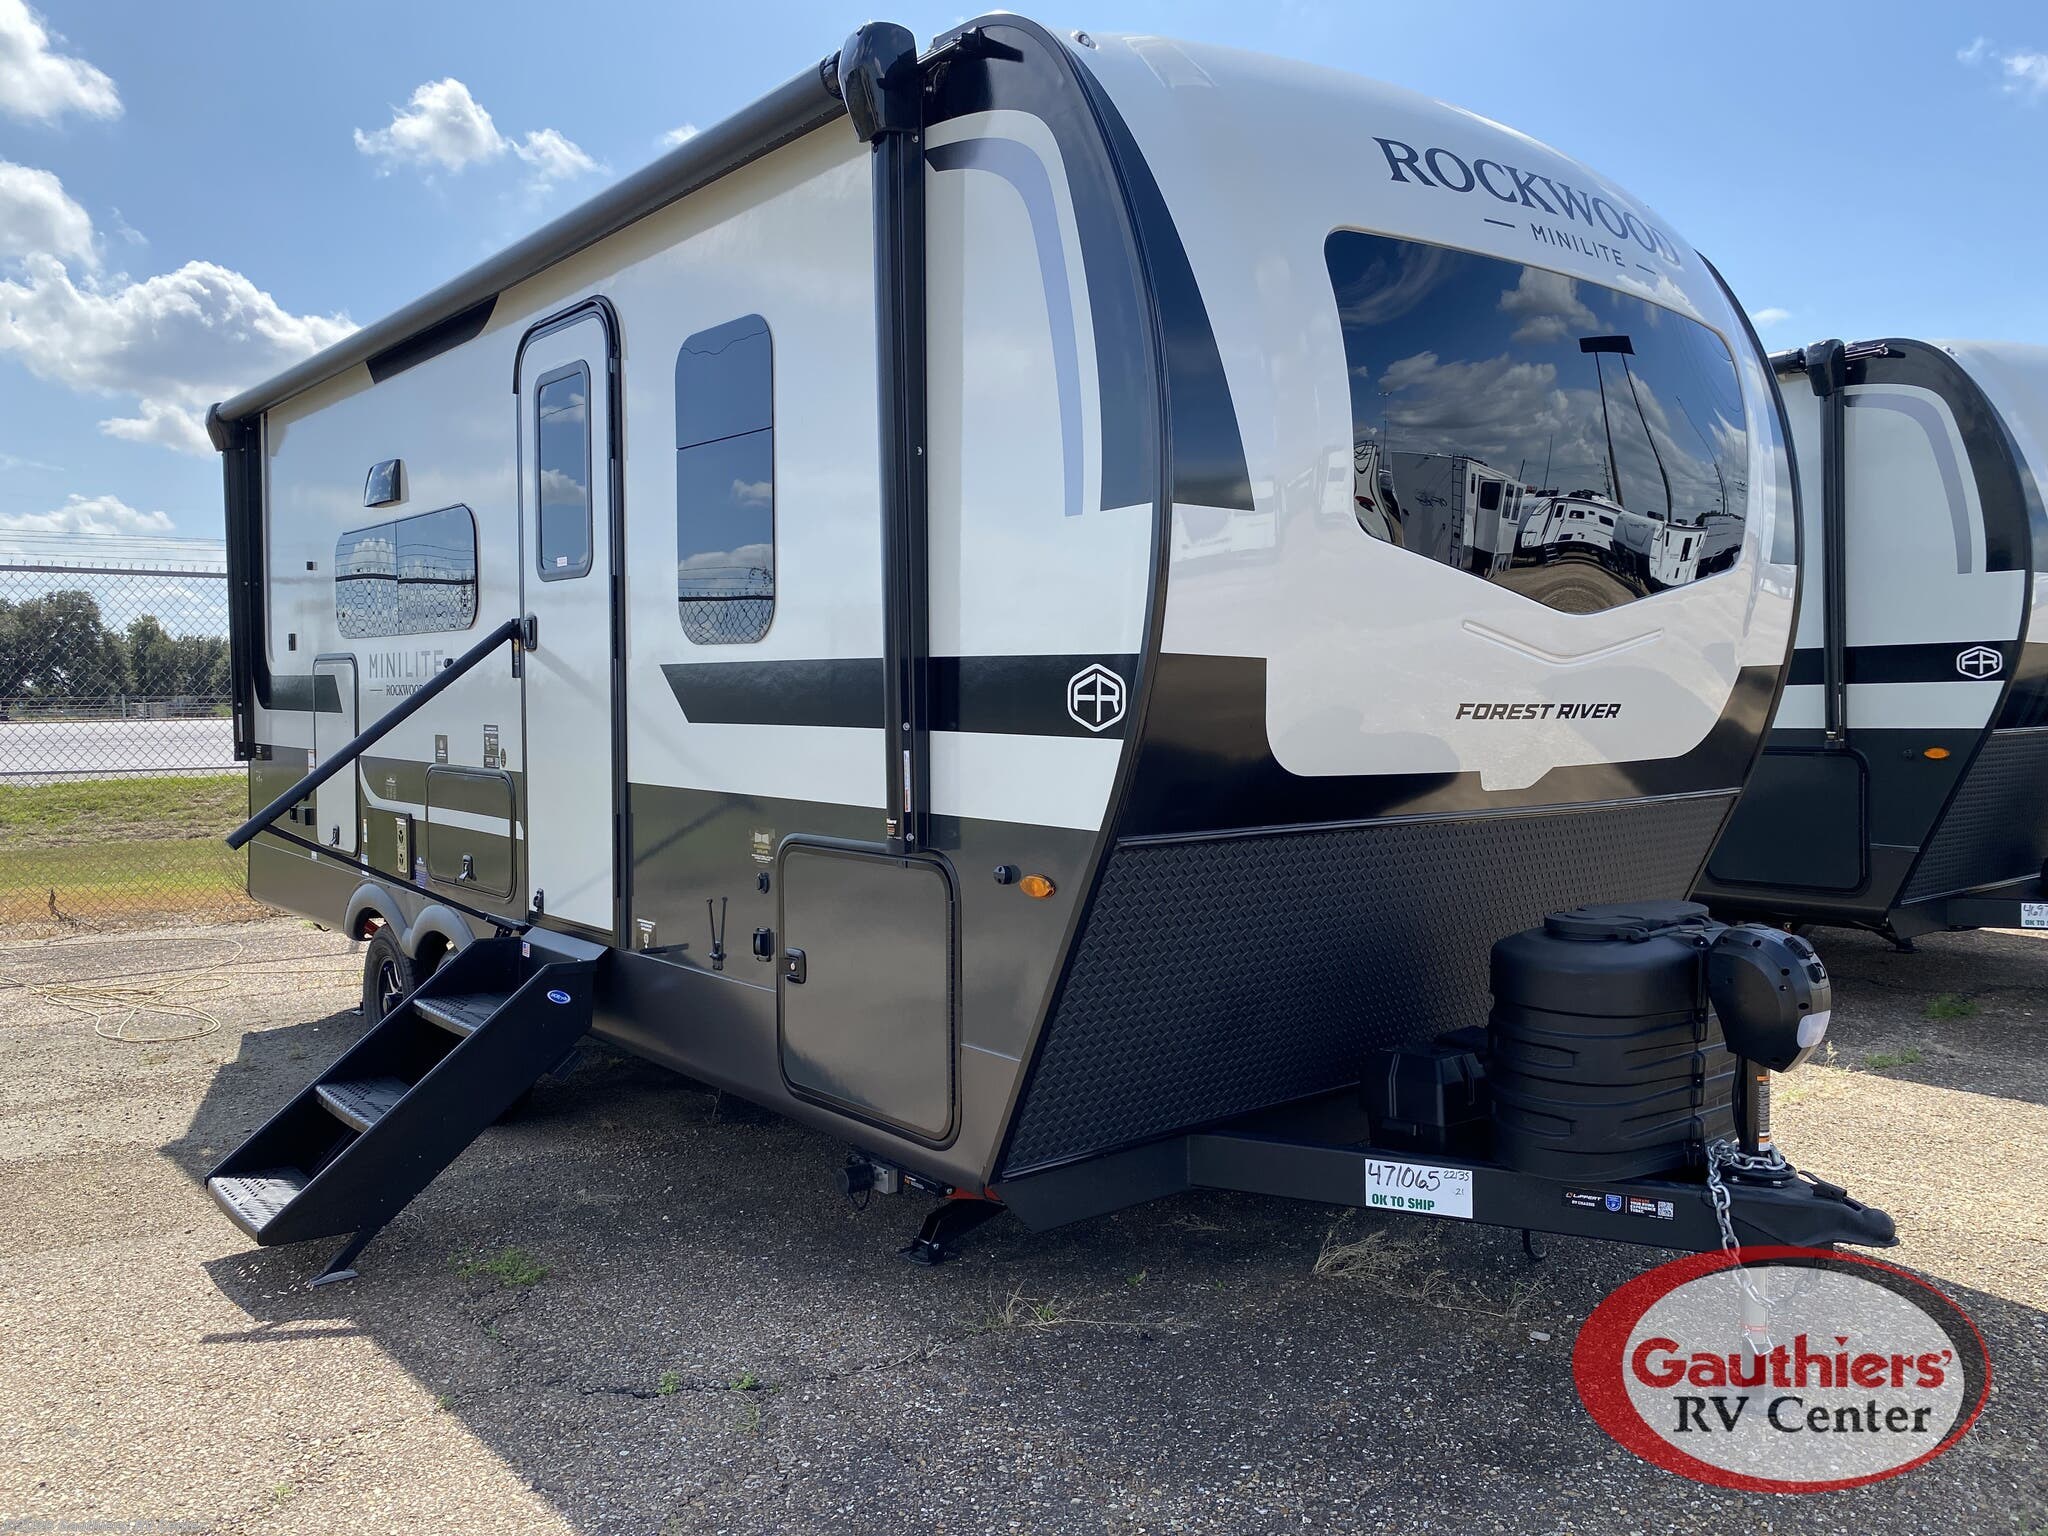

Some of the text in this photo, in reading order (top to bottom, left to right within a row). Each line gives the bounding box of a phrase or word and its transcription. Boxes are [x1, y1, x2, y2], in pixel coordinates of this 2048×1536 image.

[1372, 136, 1681, 266] ROCKWOOD
[1530, 223, 1626, 267] MINILITE
[369, 650, 444, 678] MINILITE
[1455, 703, 1621, 720] FOREST RIVER
[1368, 1162, 1441, 1192] 471065
[1371, 1193, 1435, 1211] OK TO SHIP
